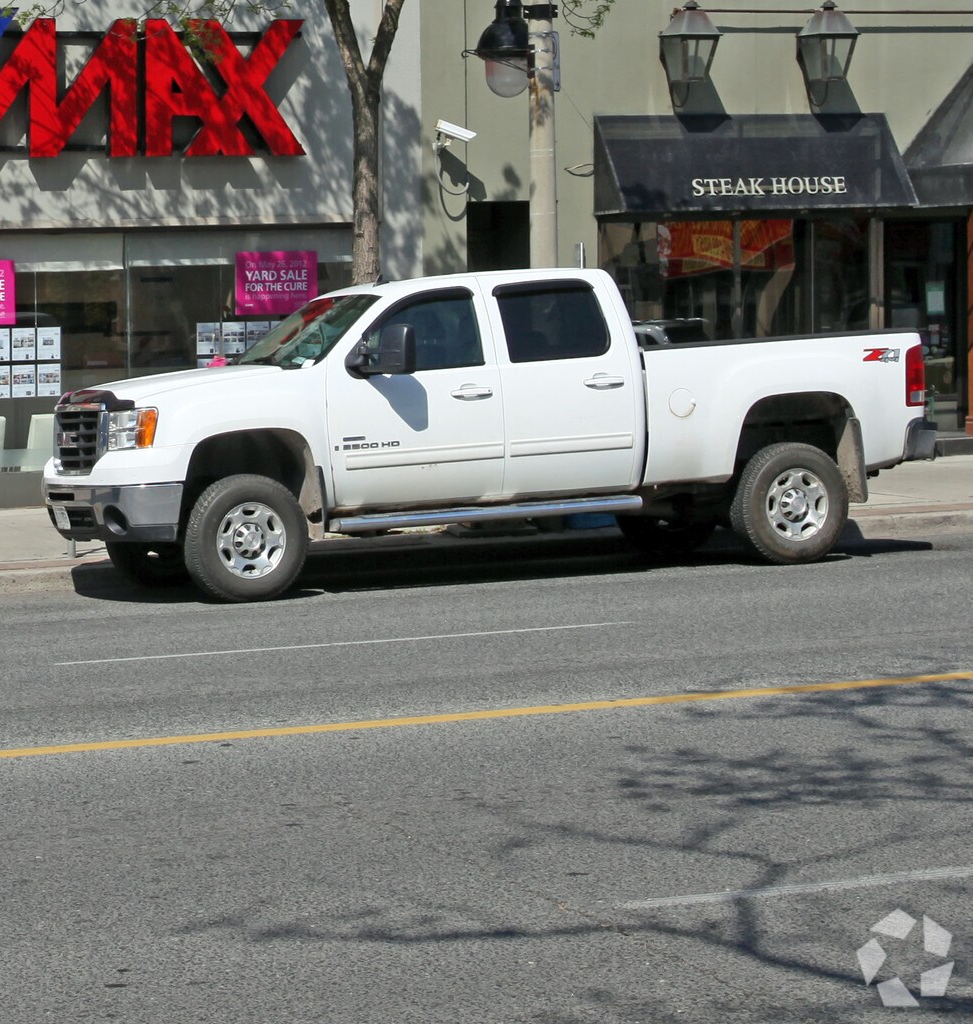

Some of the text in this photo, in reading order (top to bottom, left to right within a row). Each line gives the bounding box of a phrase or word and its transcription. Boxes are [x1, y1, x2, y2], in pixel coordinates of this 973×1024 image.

[692, 176, 848, 196] STEAK HOUSE
[246, 261, 257, 269] On
[245, 269, 308, 281] YARD SALE
[245, 282, 308, 292] FOR THE CURE
[381, 440, 400, 448] HD
